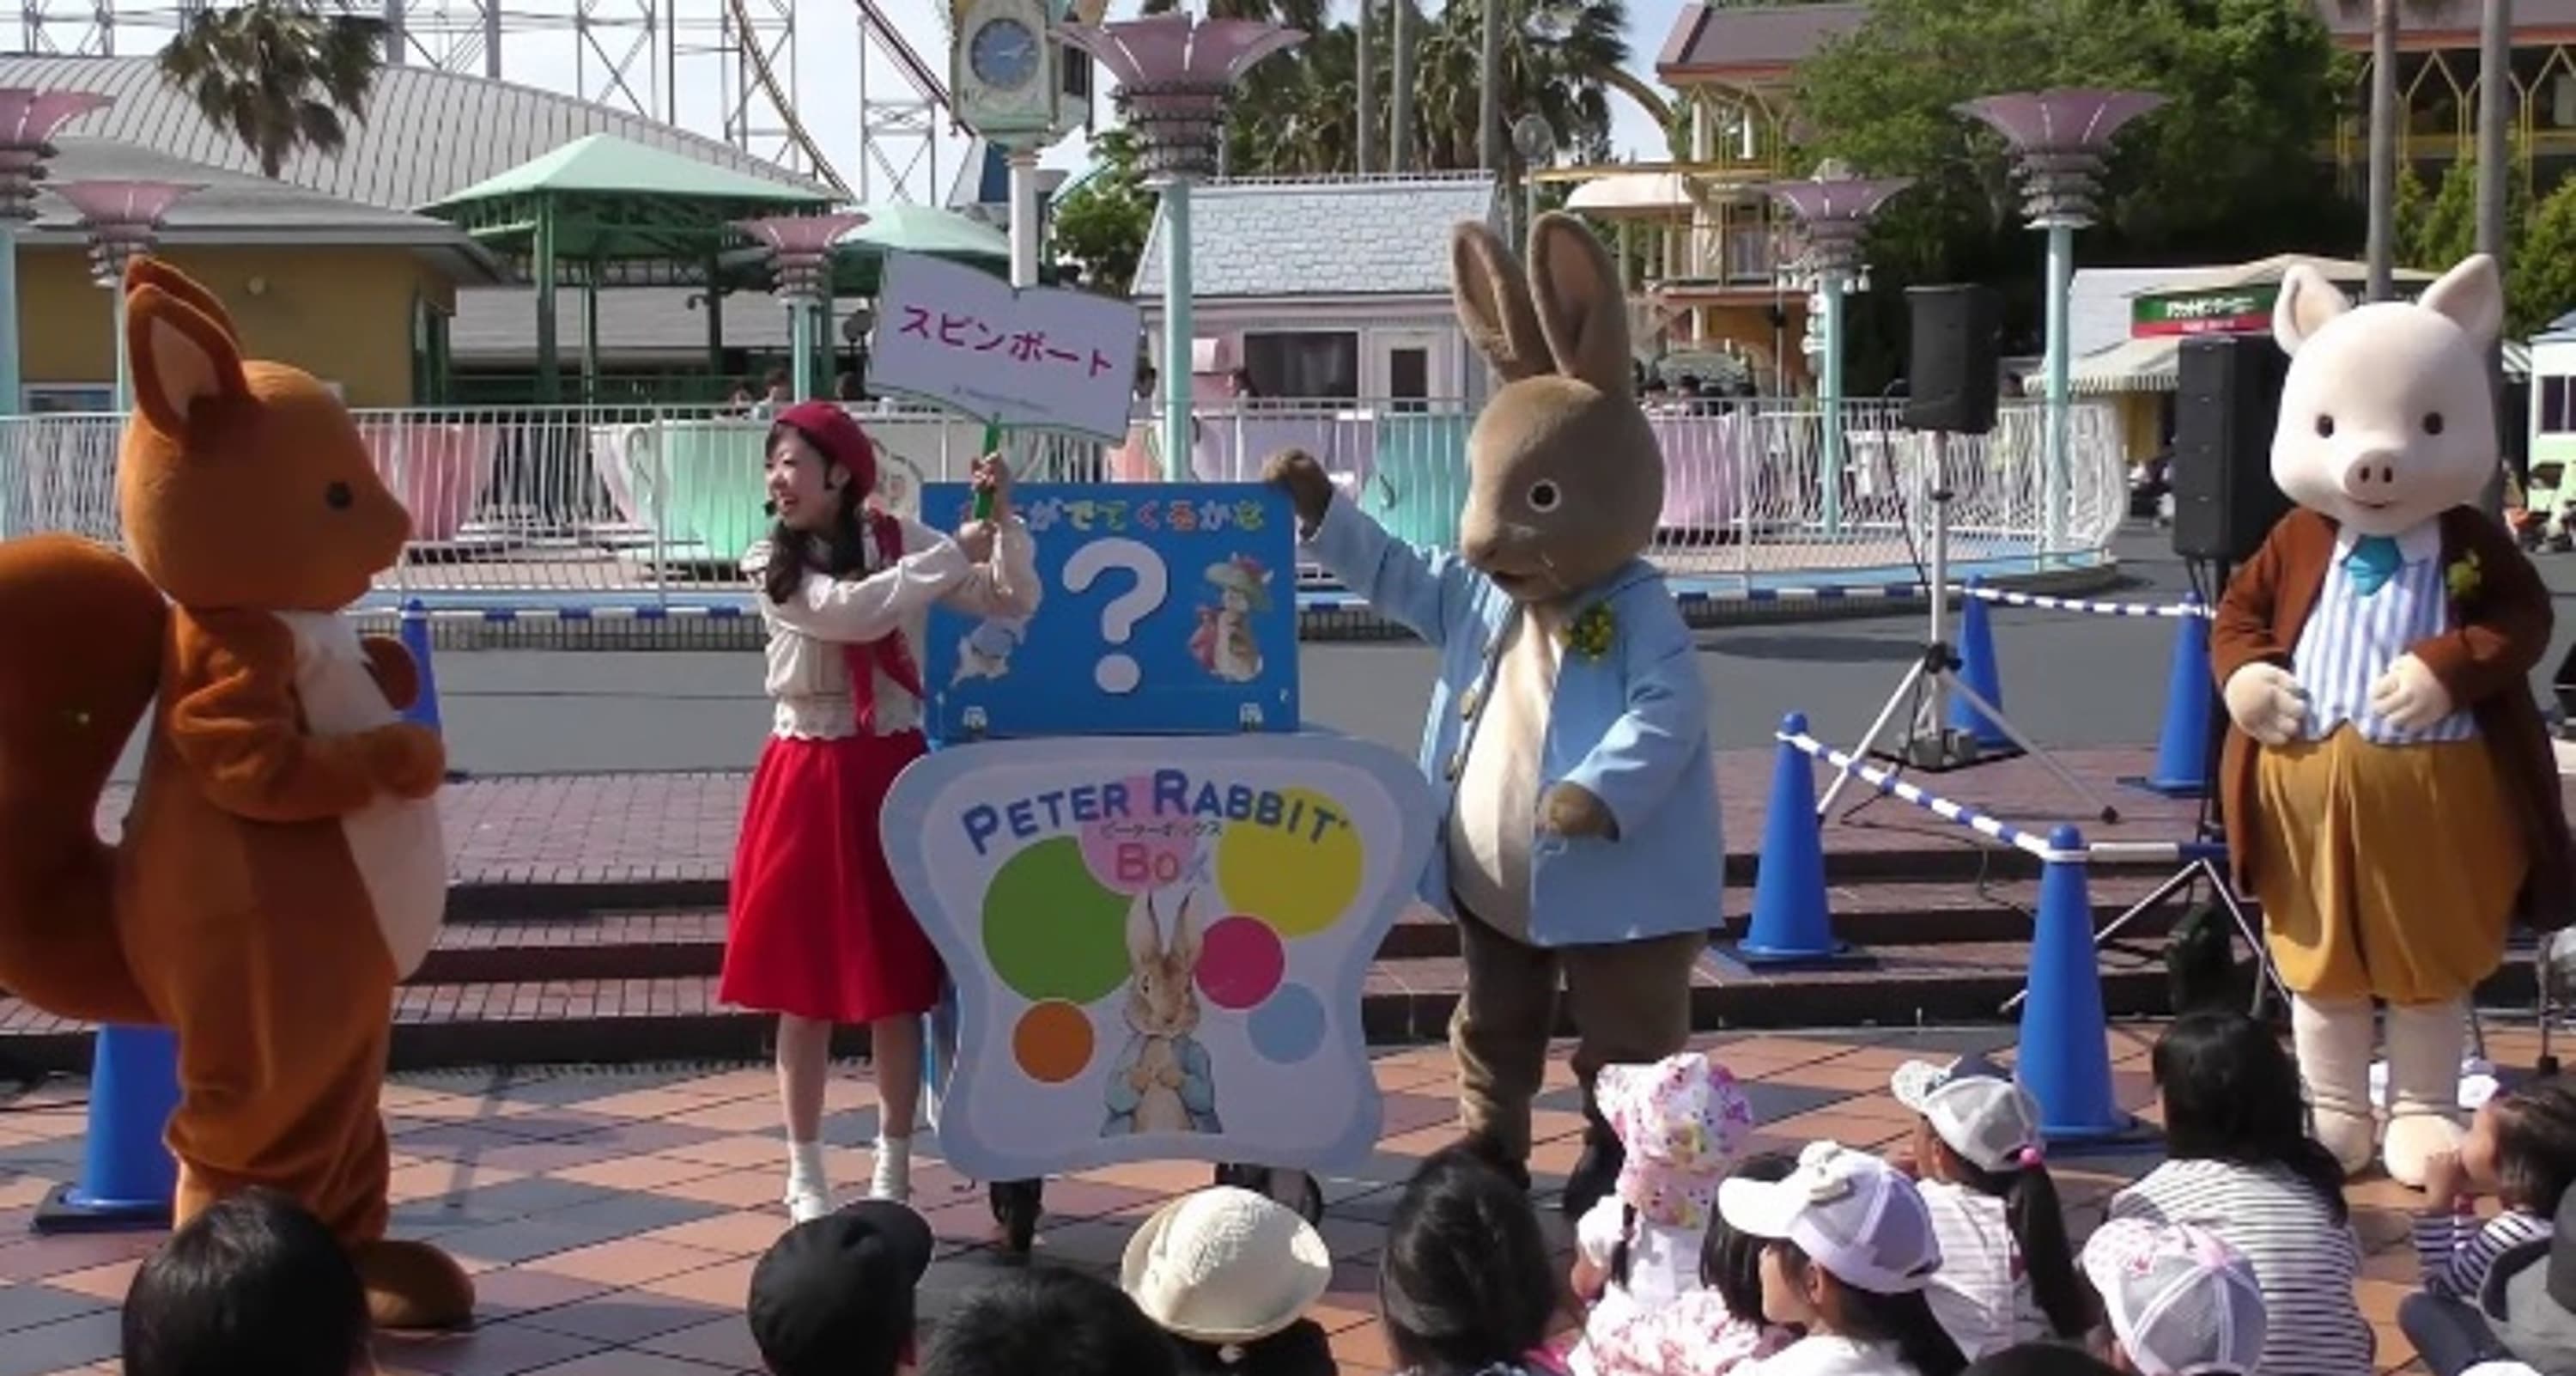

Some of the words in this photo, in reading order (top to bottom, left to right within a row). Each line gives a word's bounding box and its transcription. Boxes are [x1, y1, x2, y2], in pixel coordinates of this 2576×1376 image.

[900, 305, 1112, 377] スピンボート
[958, 497, 1265, 532] がでてくるかな
[962, 782, 1132, 855] PETER
[1152, 769, 1338, 843] RABBIT
